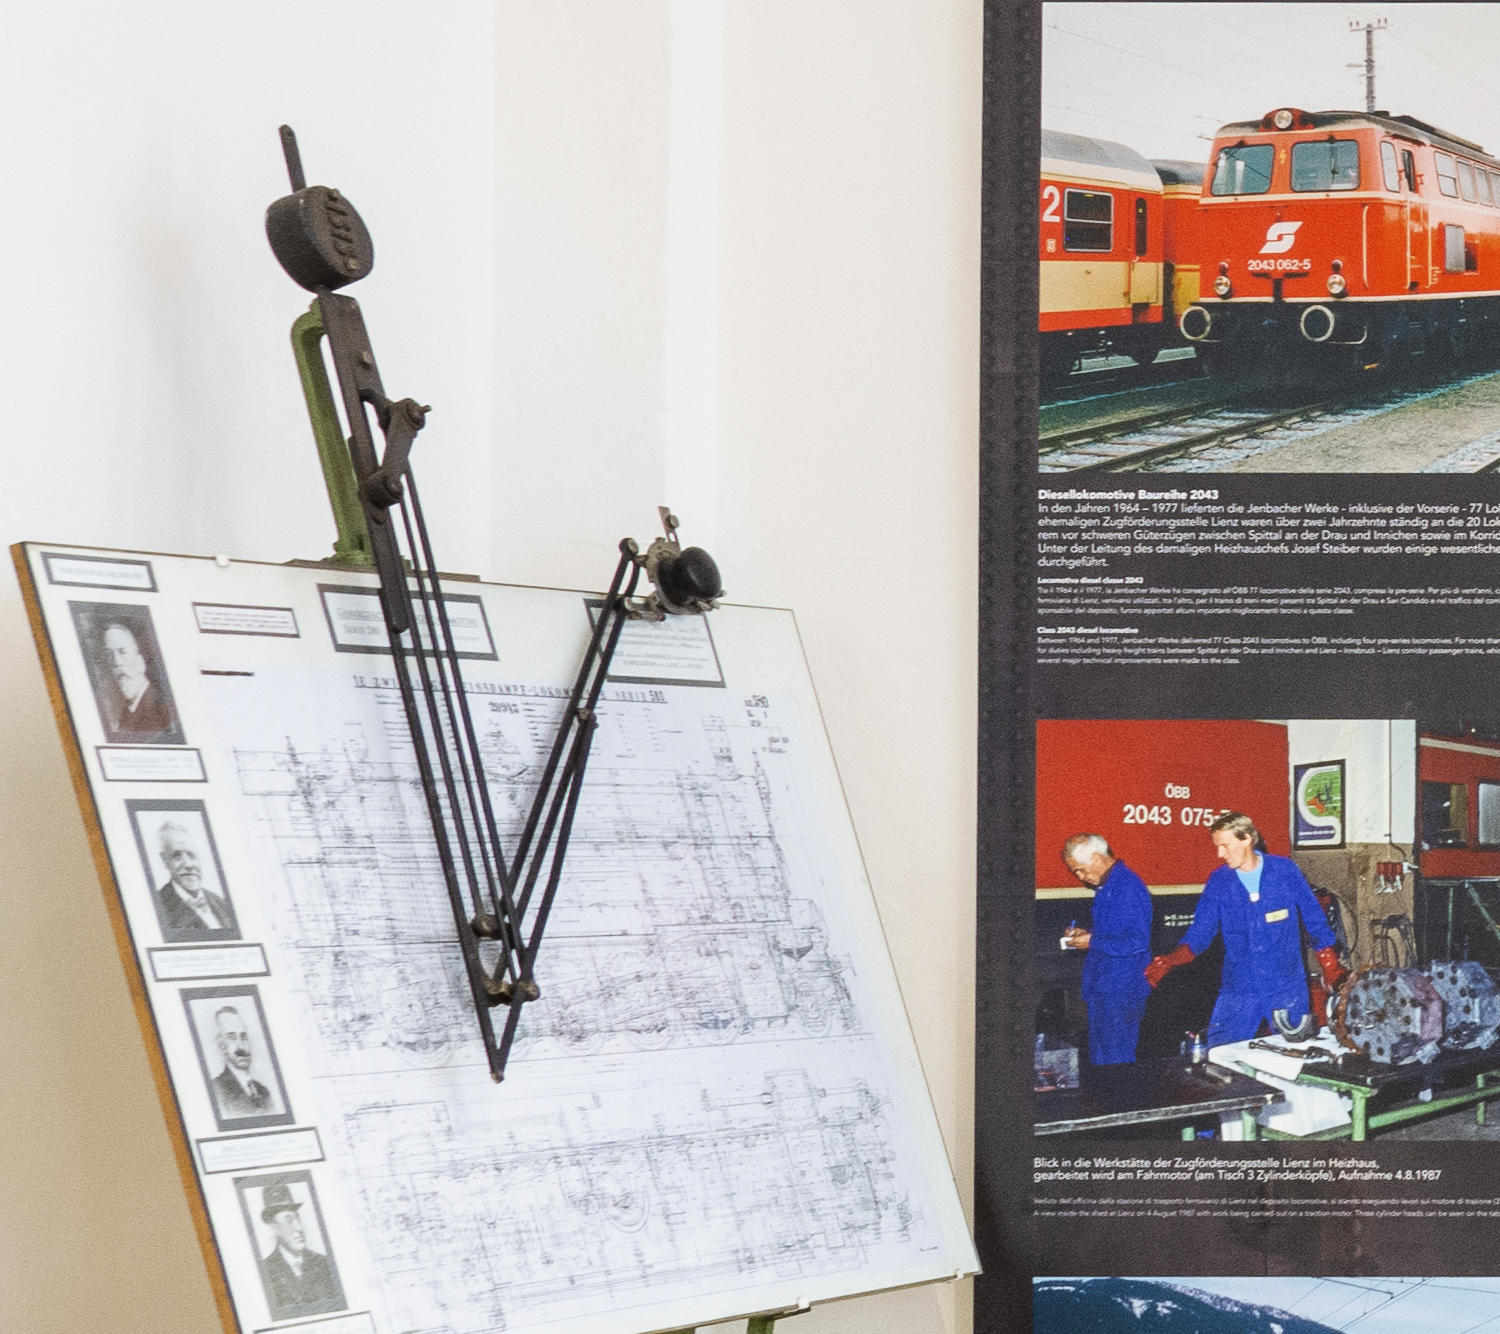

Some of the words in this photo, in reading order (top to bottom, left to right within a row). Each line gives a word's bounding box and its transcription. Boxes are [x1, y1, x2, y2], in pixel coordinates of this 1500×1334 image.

[1042, 185, 1061, 223] 2
[1248, 259, 1275, 271] 2043
[1277, 258, 1311, 270] 062-5
[1038, 489, 1135, 500] Diesellokomotive
[1138, 489, 1188, 500] Baureihe
[1190, 489, 1218, 500] 2043
[1165, 783, 1190, 799] ÖBB
[1123, 804, 1172, 825] 2043
